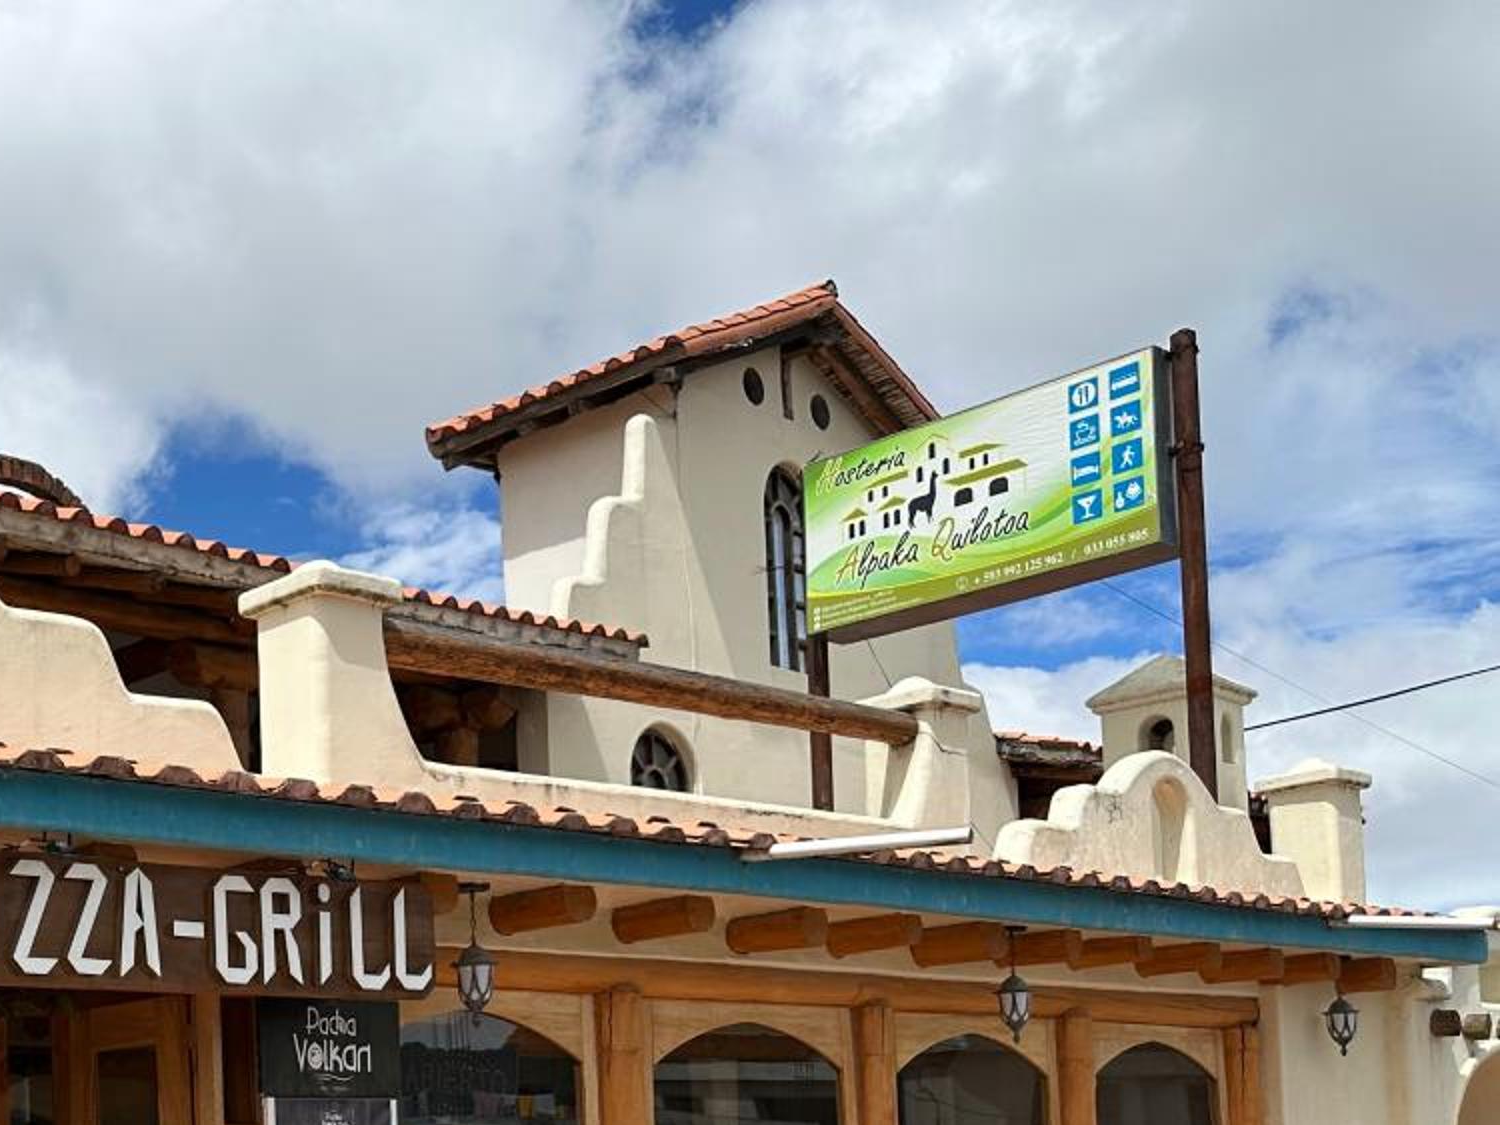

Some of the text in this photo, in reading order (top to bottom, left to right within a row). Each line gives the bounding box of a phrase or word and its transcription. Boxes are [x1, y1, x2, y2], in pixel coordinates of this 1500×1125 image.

[836, 506, 1029, 590] Alpaka Quilotoa
[306, 1006, 357, 1038] Pacha
[293, 1033, 372, 1074] Volkan
